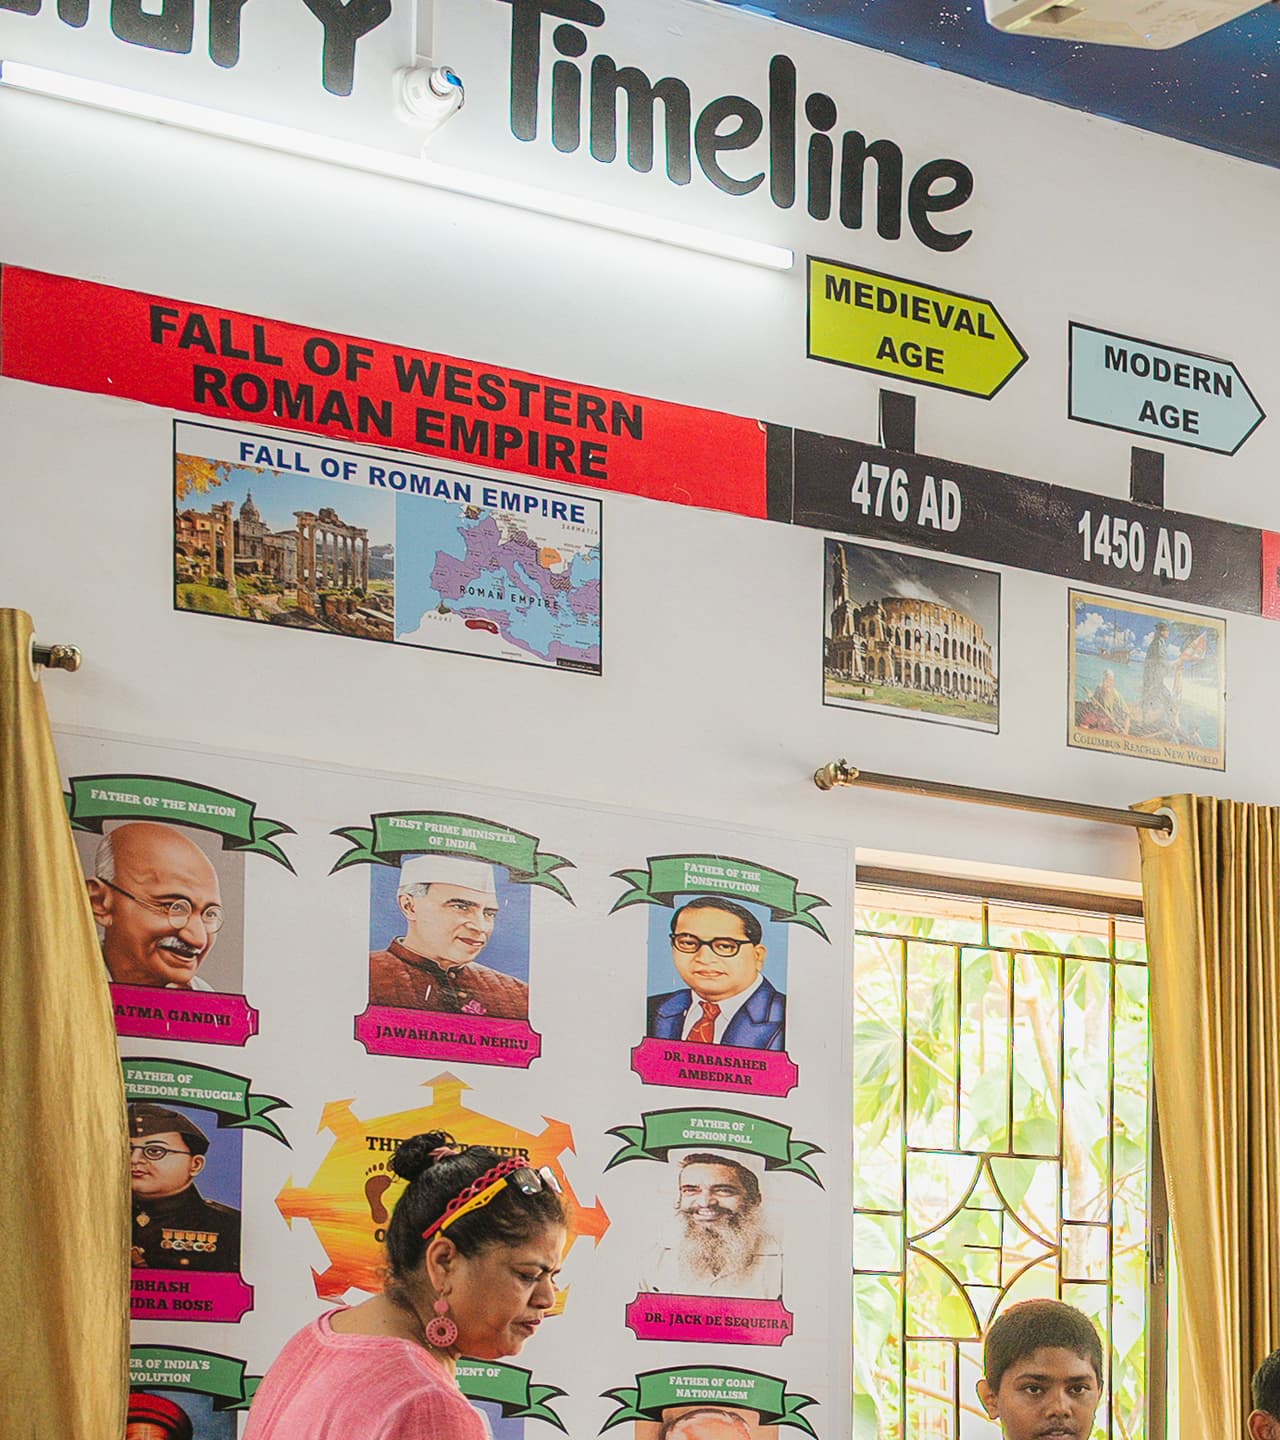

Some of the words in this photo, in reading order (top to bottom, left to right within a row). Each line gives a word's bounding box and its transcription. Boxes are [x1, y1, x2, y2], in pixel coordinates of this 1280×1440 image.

[505, 0, 974, 252] Timeline
[825, 274, 996, 340] MEDIEVAL
[876, 336, 945, 374] AGE
[150, 305, 283, 367] FALL
[303, 336, 375, 381] OF
[394, 353, 644, 440] WESTERN
[1104, 344, 1233, 398] MODERN
[193, 363, 393, 437] ROMAN
[416, 407, 607, 480] EMPIRE
[1138, 400, 1200, 435] AGE
[239, 441, 310, 472] FALL
[320, 457, 358, 481] OF
[368, 468, 472, 504] ROMAN
[482, 488, 585, 524] EMPIRE
[851, 461, 909, 522] 476
[918, 475, 962, 532] AD
[1077, 510, 1145, 572] 1450
[1153, 527, 1193, 581] AD
[459, 585, 503, 601] ROMAN
[511, 594, 559, 610] EMPIRE
[90, 789, 141, 806] FATHER
[143, 797, 160, 808] OF
[162, 799, 187, 812] THE
[188, 803, 236, 818] NATION
[388, 817, 422, 830] FIRST
[424, 822, 460, 836] PRIME
[462, 828, 517, 844] MINISTER
[428, 835, 444, 846] OF
[445, 838, 478, 851] INDIA
[684, 862, 724, 877] FATHER
[726, 868, 741, 878] OF
[743, 869, 761, 881] THE
[114, 1005, 164, 1021] ATMA
[168, 1010, 232, 1026] GANDHI
[376, 1025, 476, 1046] JAWAHARLAL
[480, 1035, 529, 1050] NEHRU
[663, 1050, 685, 1063] DR.
[687, 1053, 767, 1071] BABASAHEB
[127, 1070, 175, 1083] FATHER
[178, 1074, 193, 1084] OF
[678, 1069, 752, 1085] AMBEDKAR
[181, 1086, 243, 1101] STRUGGLE
[690, 1118, 730, 1131] FATHER
[732, 1121, 745, 1131] OF
[682, 1129, 727, 1142] OPENION
[729, 1132, 752, 1144] POLL
[172, 1299, 213, 1311] BOSE
[645, 1312, 666, 1324] DR.
[669, 1313, 702, 1326] JACK
[705, 1316, 722, 1326] DE
[725, 1317, 789, 1330] SEQUEIRA
[145, 1359, 162, 1369] OF
[486, 1368, 501, 1377] OF
[130, 1372, 191, 1383] VOLUTION
[669, 1376, 710, 1387] FATHER
[711, 1378, 725, 1387] OF
[726, 1379, 755, 1389] GOAN
[676, 1389, 748, 1400] NATIONALISM
